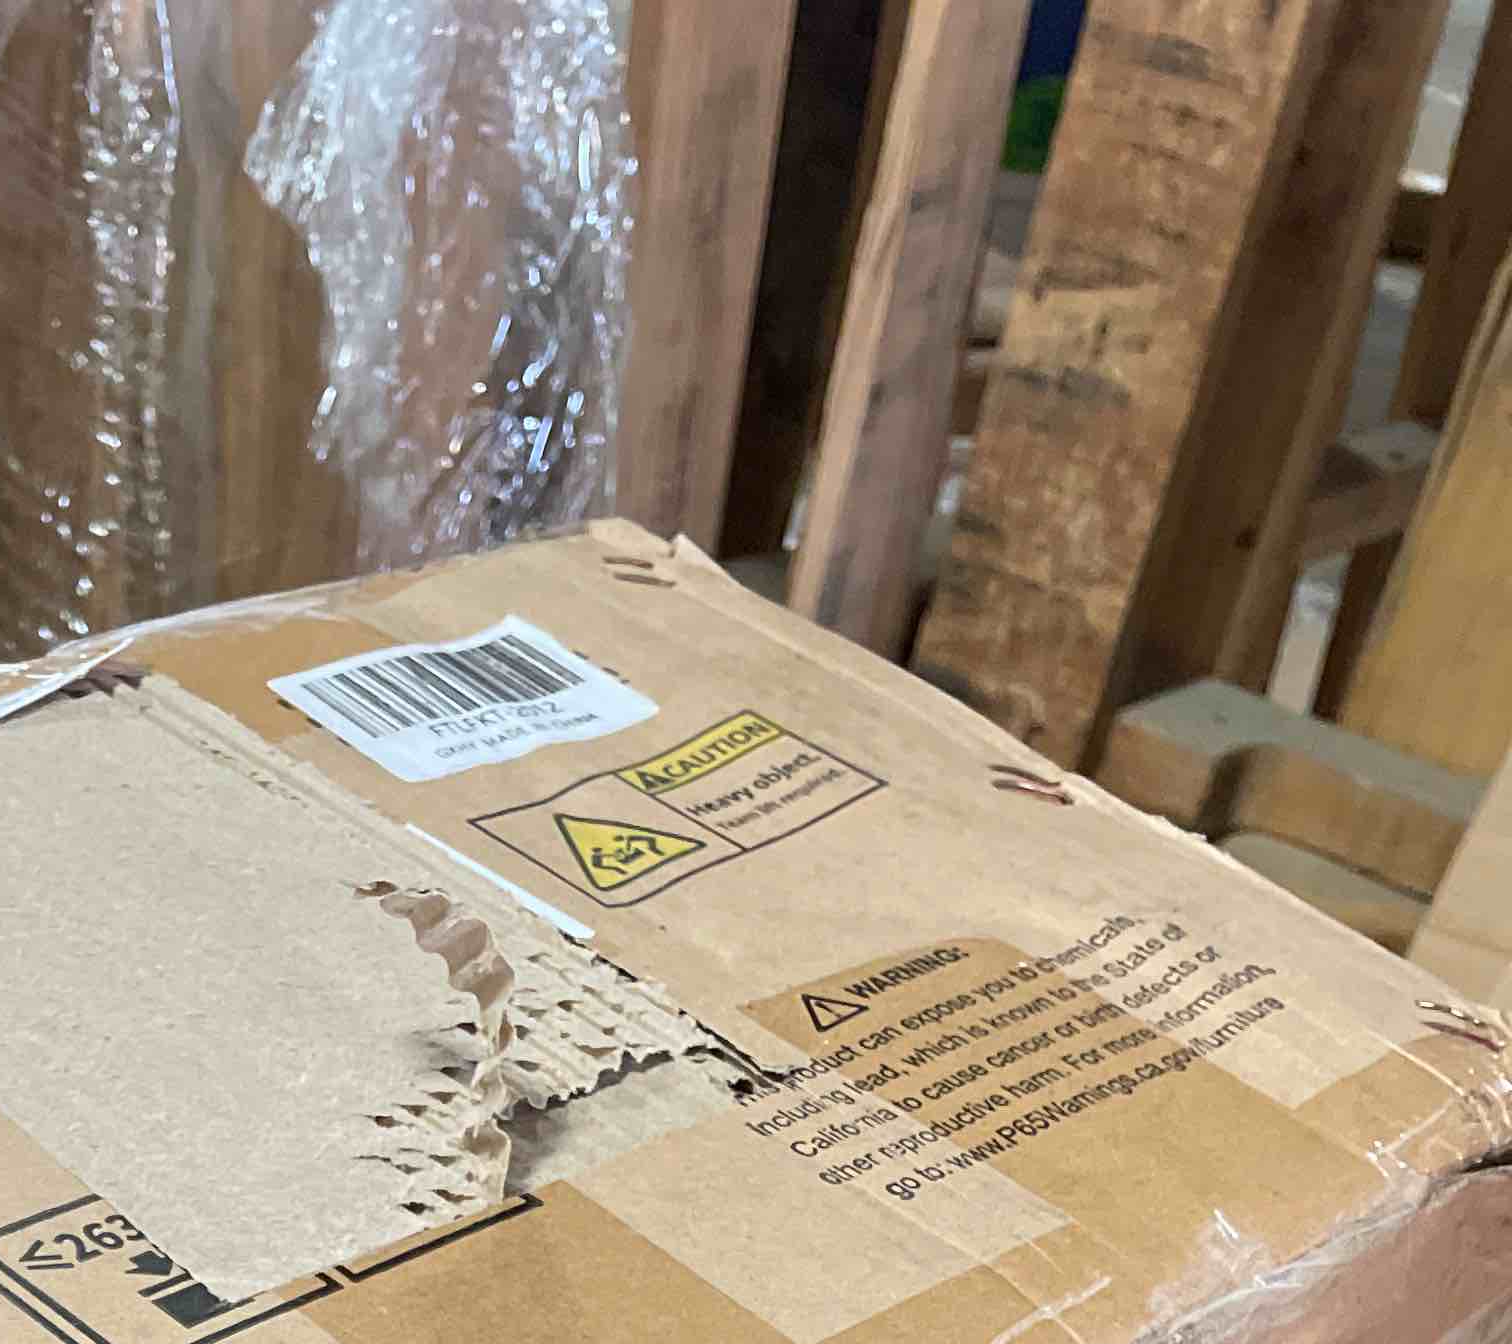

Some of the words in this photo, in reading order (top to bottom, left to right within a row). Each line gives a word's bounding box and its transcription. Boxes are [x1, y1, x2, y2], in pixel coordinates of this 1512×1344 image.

[663, 720, 769, 778] CAUTION
[686, 785, 755, 817] Heavy
[843, 1062, 911, 1095] lead,
[901, 1026, 970, 1068] which
[960, 1021, 989, 1041] is
[981, 996, 1056, 1031] known
[1048, 985, 1077, 1002] to
[1070, 970, 1111, 993] the
[1102, 935, 1166, 979] State
[1162, 921, 1187, 943] of
[844, 945, 969, 1000] WARNING:
[858, 1026, 904, 1051] can
[900, 994, 976, 1032] expose
[972, 973, 1016, 1002] you
[1009, 963, 1039, 983] to
[790, 1105, 899, 1158] California
[890, 1095, 923, 1113] to
[920, 1062, 988, 1101] cause
[986, 1030, 1058, 1069] cancer
[1053, 1020, 1081, 1039] or
[1076, 1001, 1129, 1029] birth
[1121, 958, 1199, 1010] defects
[1194, 944, 1223, 964] or
[818, 1151, 881, 1185] other
[877, 1084, 1010, 1164] reproductive
[999, 1064, 1073, 1099] harm.
[1060, 1046, 1106, 1072] For
[1103, 1027, 1158, 1053] more
[885, 1175, 922, 1201] go
